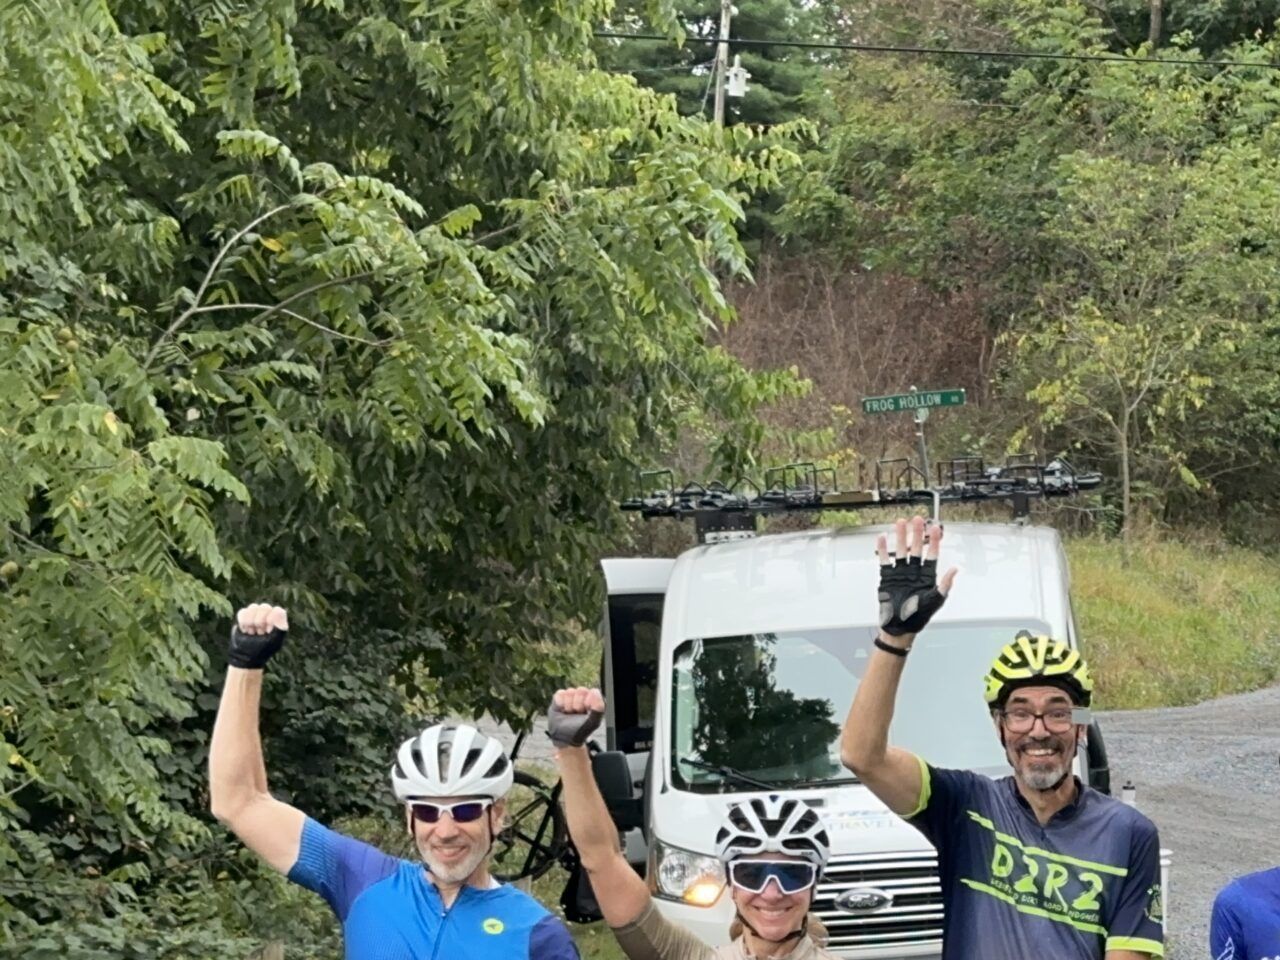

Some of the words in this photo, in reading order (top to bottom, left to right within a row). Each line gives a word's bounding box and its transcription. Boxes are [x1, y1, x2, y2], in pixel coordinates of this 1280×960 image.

[865, 398, 895, 412] FROG
[899, 393, 941, 409] HOLLOW
[847, 893, 879, 909] Ford
